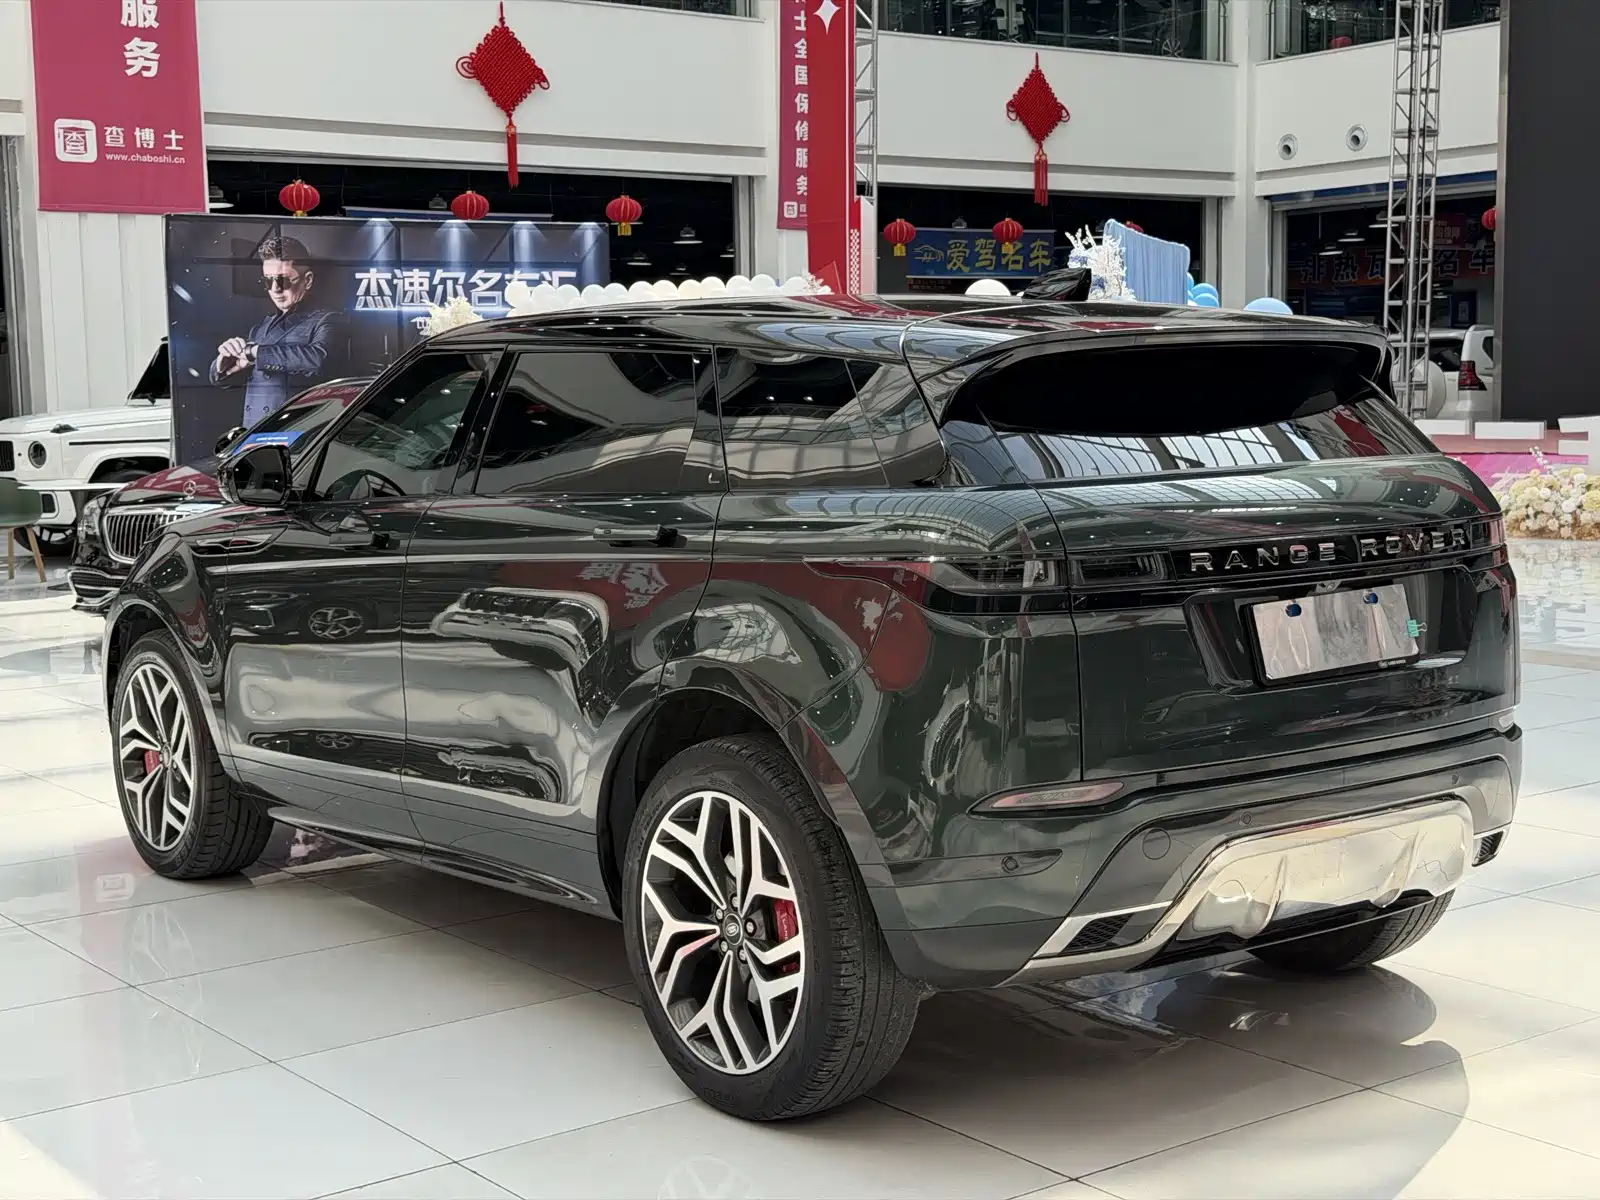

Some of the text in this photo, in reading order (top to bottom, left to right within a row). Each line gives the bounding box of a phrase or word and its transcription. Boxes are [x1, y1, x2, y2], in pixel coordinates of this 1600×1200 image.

[120, 0, 161, 78] 服务
[793, 0, 809, 196] 士全国保修服务
[104, 125, 184, 150] 查博士
[105, 152, 186, 165] www.chaboshi.cn
[946, 237, 1052, 273] 爱驾名车
[1189, 528, 1467, 571] RANGE ROVER
